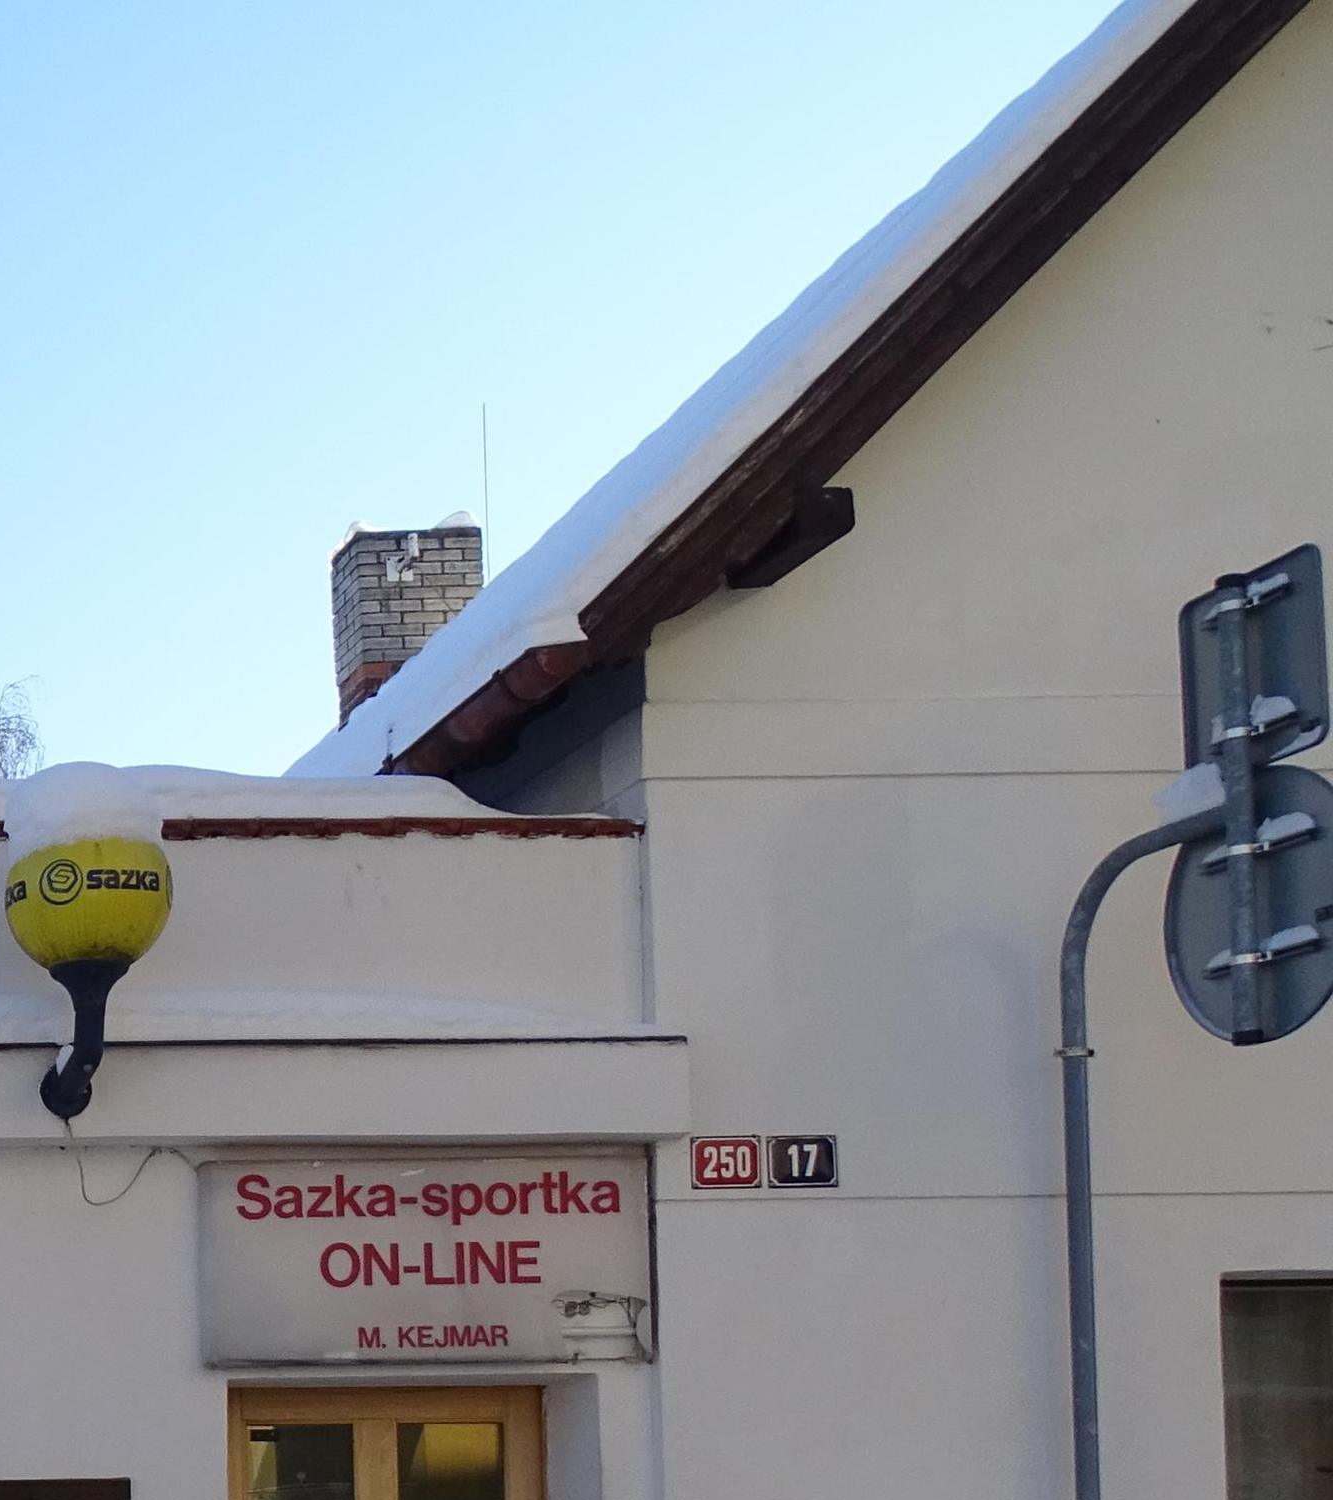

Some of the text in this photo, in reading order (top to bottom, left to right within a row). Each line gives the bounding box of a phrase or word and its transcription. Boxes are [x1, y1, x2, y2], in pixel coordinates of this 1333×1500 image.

[86, 869, 160, 892] sazka
[702, 1145, 752, 1180] 250
[787, 1143, 818, 1178] 17
[236, 1170, 621, 1226] Sazka-sportka
[319, 1240, 543, 1289] ON-LINE
[358, 1324, 510, 1350] M. KEJMAR
